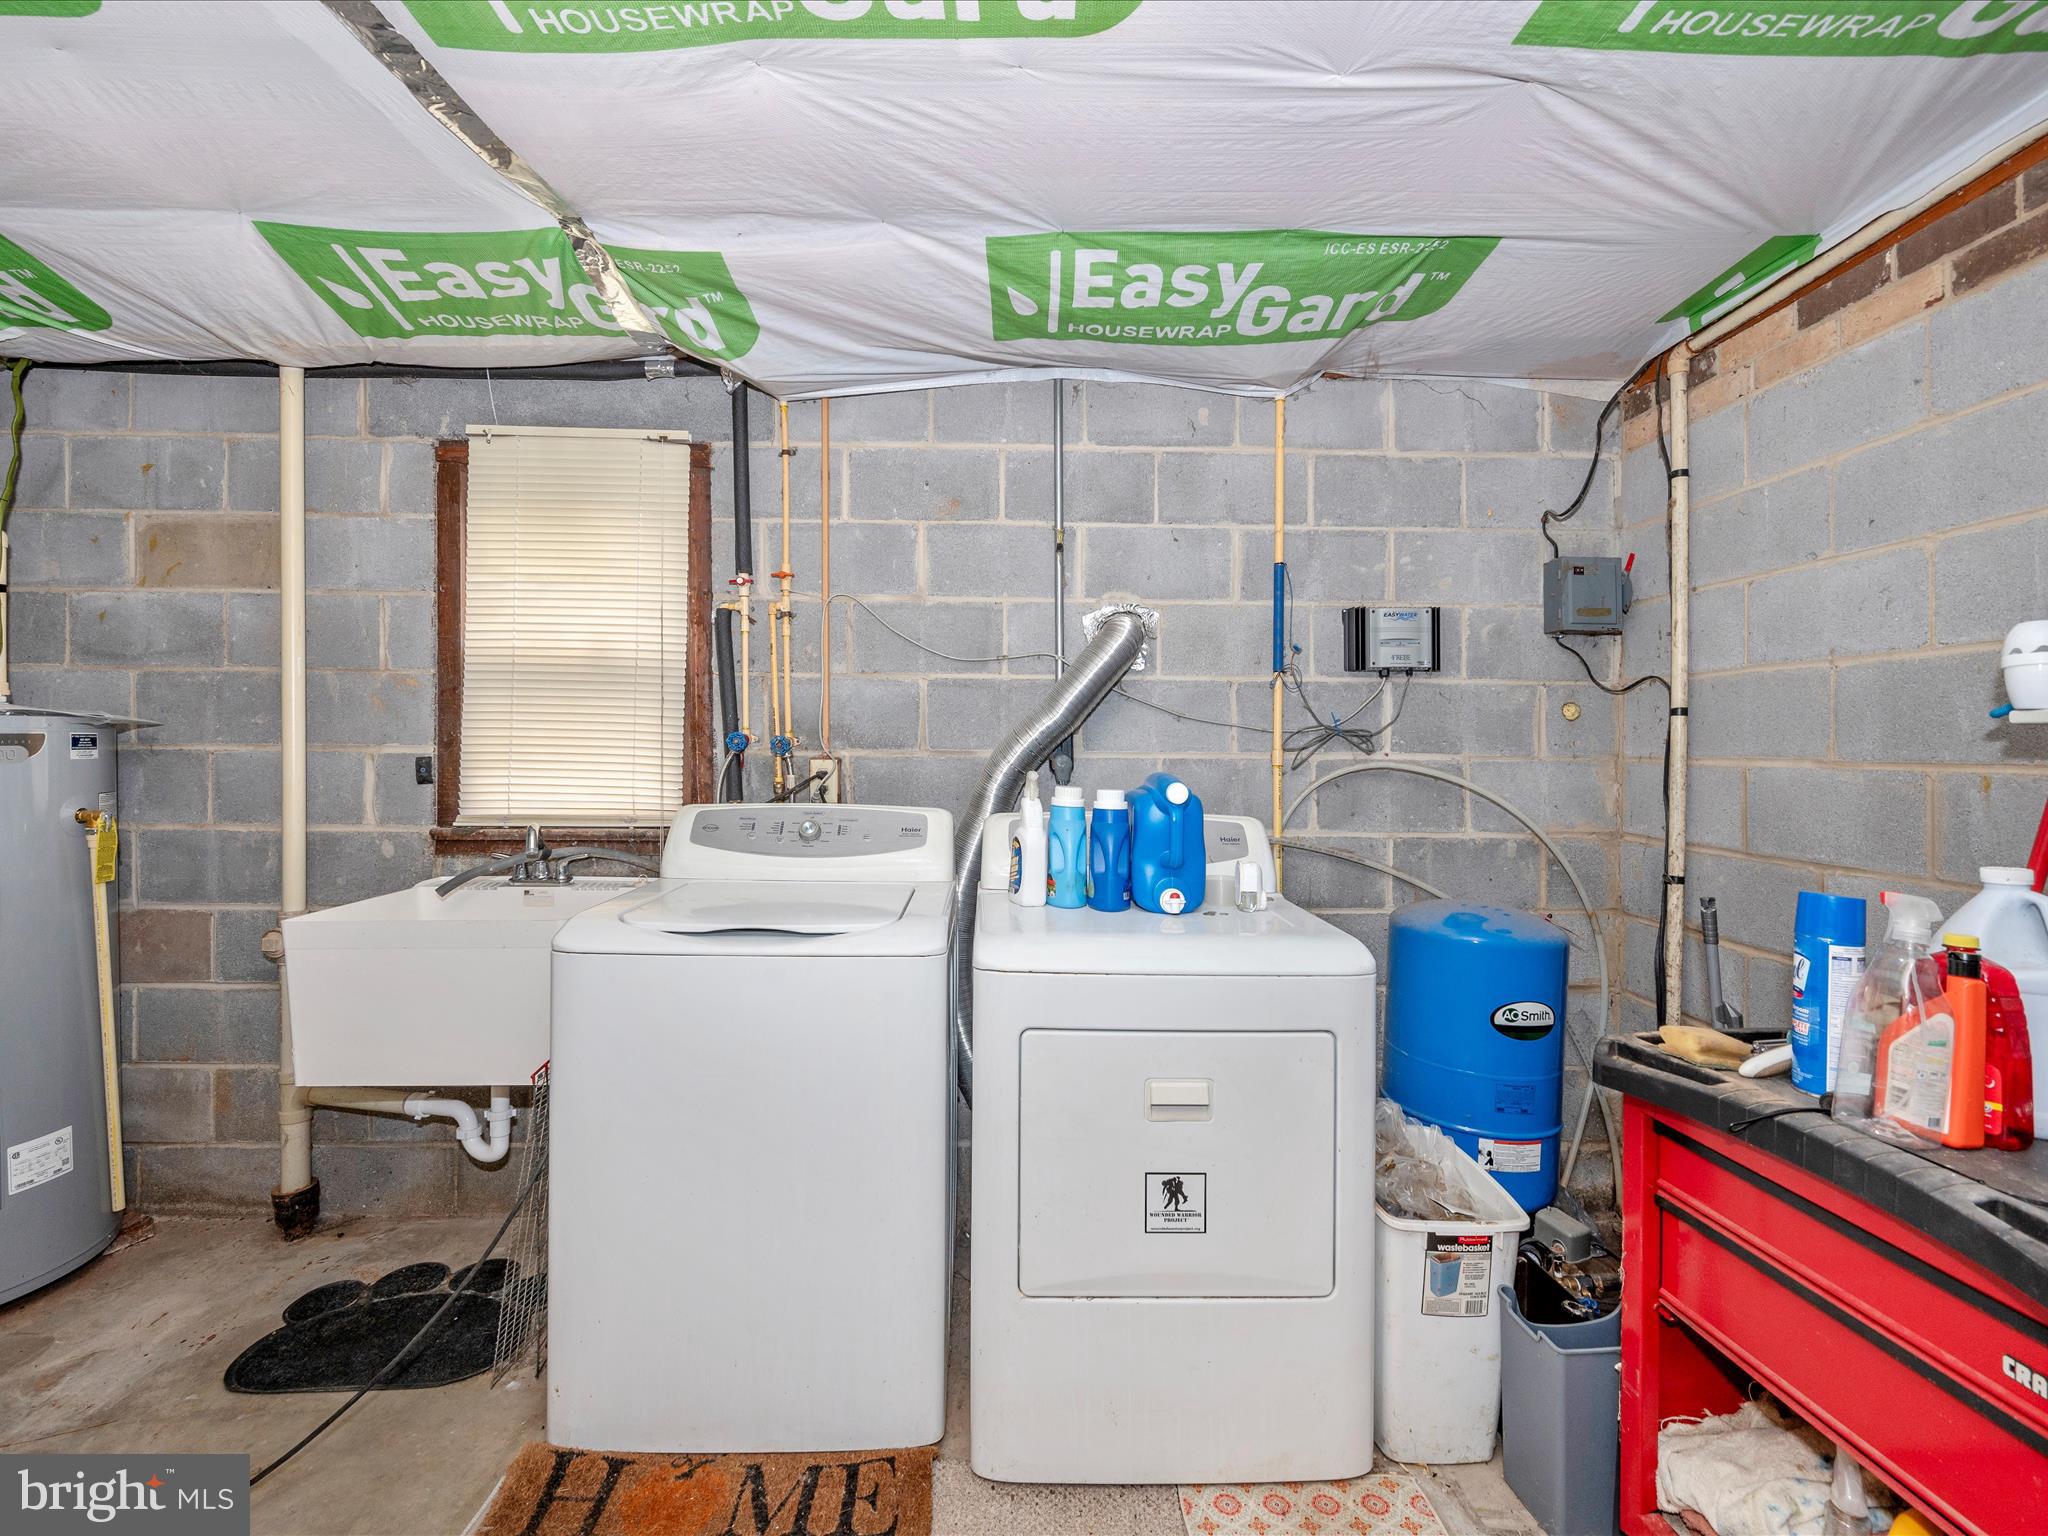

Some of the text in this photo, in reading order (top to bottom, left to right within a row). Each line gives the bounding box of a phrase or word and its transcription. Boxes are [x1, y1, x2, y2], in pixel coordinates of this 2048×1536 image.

[534, 0, 795, 35] HOUSEWRAP
[1651, 10, 1936, 38] HOUSEWRAP
[1324, 242, 1376, 255] ICC-ES
[356, 247, 566, 310] Easy
[1072, 249, 1264, 319] Easy
[1235, 273, 1426, 337] Gard
[418, 313, 584, 329] HOUSEWRAP
[1067, 323, 1232, 340] HOUSEWRAP
[1520, 1010, 1550, 1022] Smith
[1437, 1243, 1490, 1252] wastebasket
